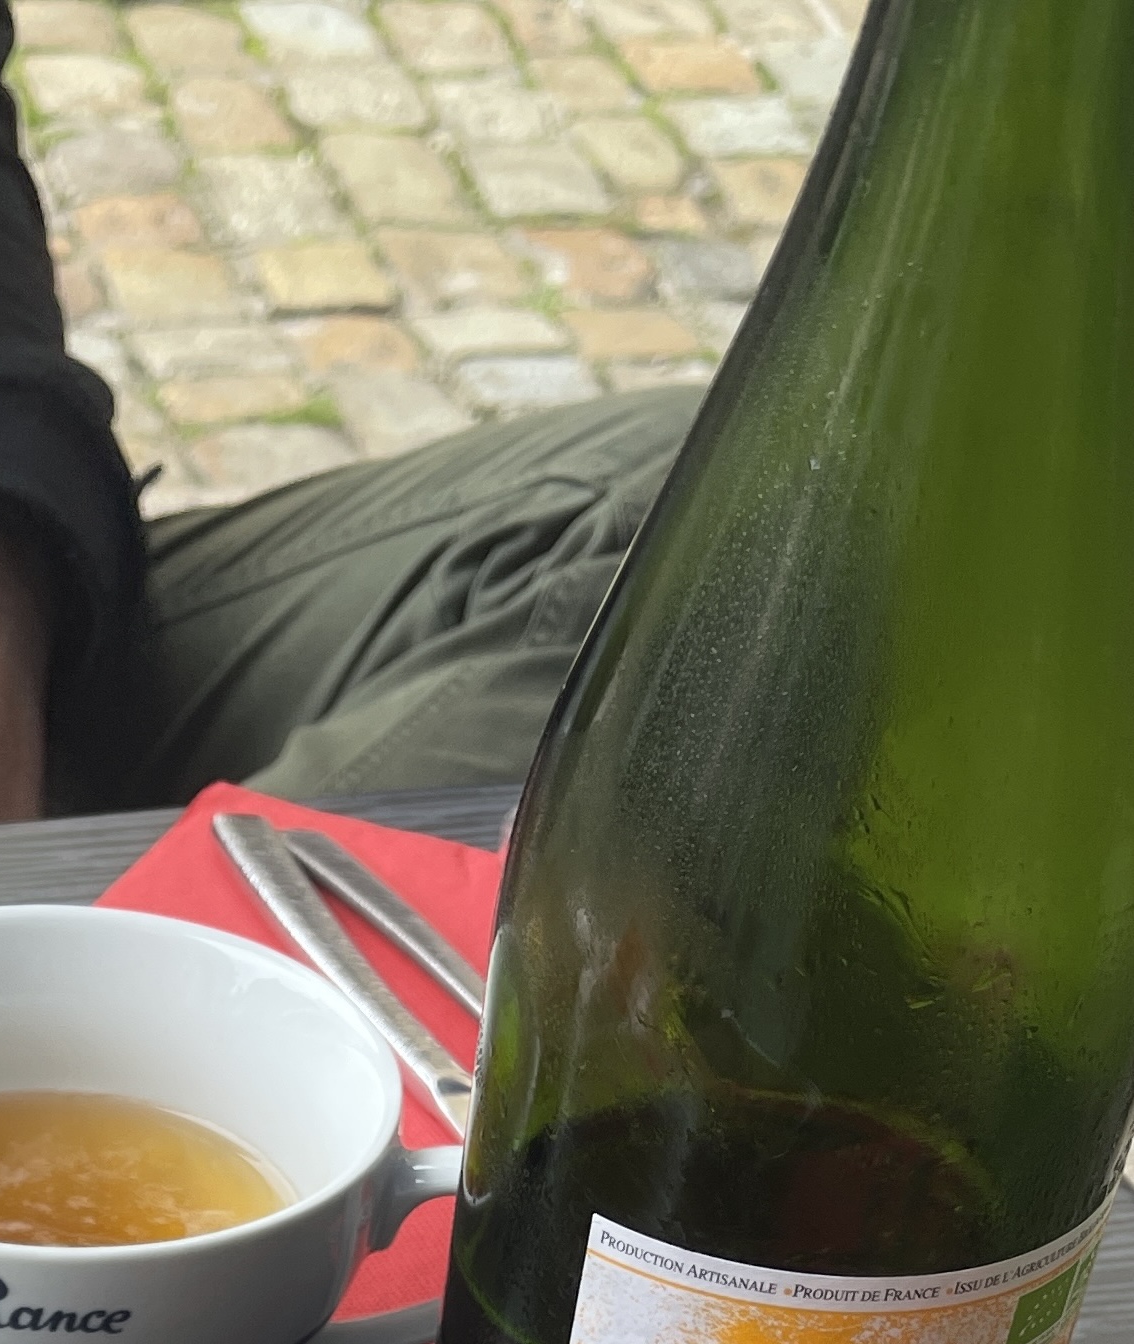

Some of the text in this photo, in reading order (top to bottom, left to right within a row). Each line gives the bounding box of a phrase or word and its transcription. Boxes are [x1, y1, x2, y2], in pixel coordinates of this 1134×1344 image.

[600, 1229, 685, 1273] PRODUCTION
[686, 1264, 778, 1294] ARTISANALE
[792, 1283, 859, 1302] PRODUIT
[861, 1290, 881, 1302] DE
[883, 1286, 941, 1302] FRANCE
[953, 1280, 985, 1295] ISSU
[984, 1273, 1002, 1289] DE
